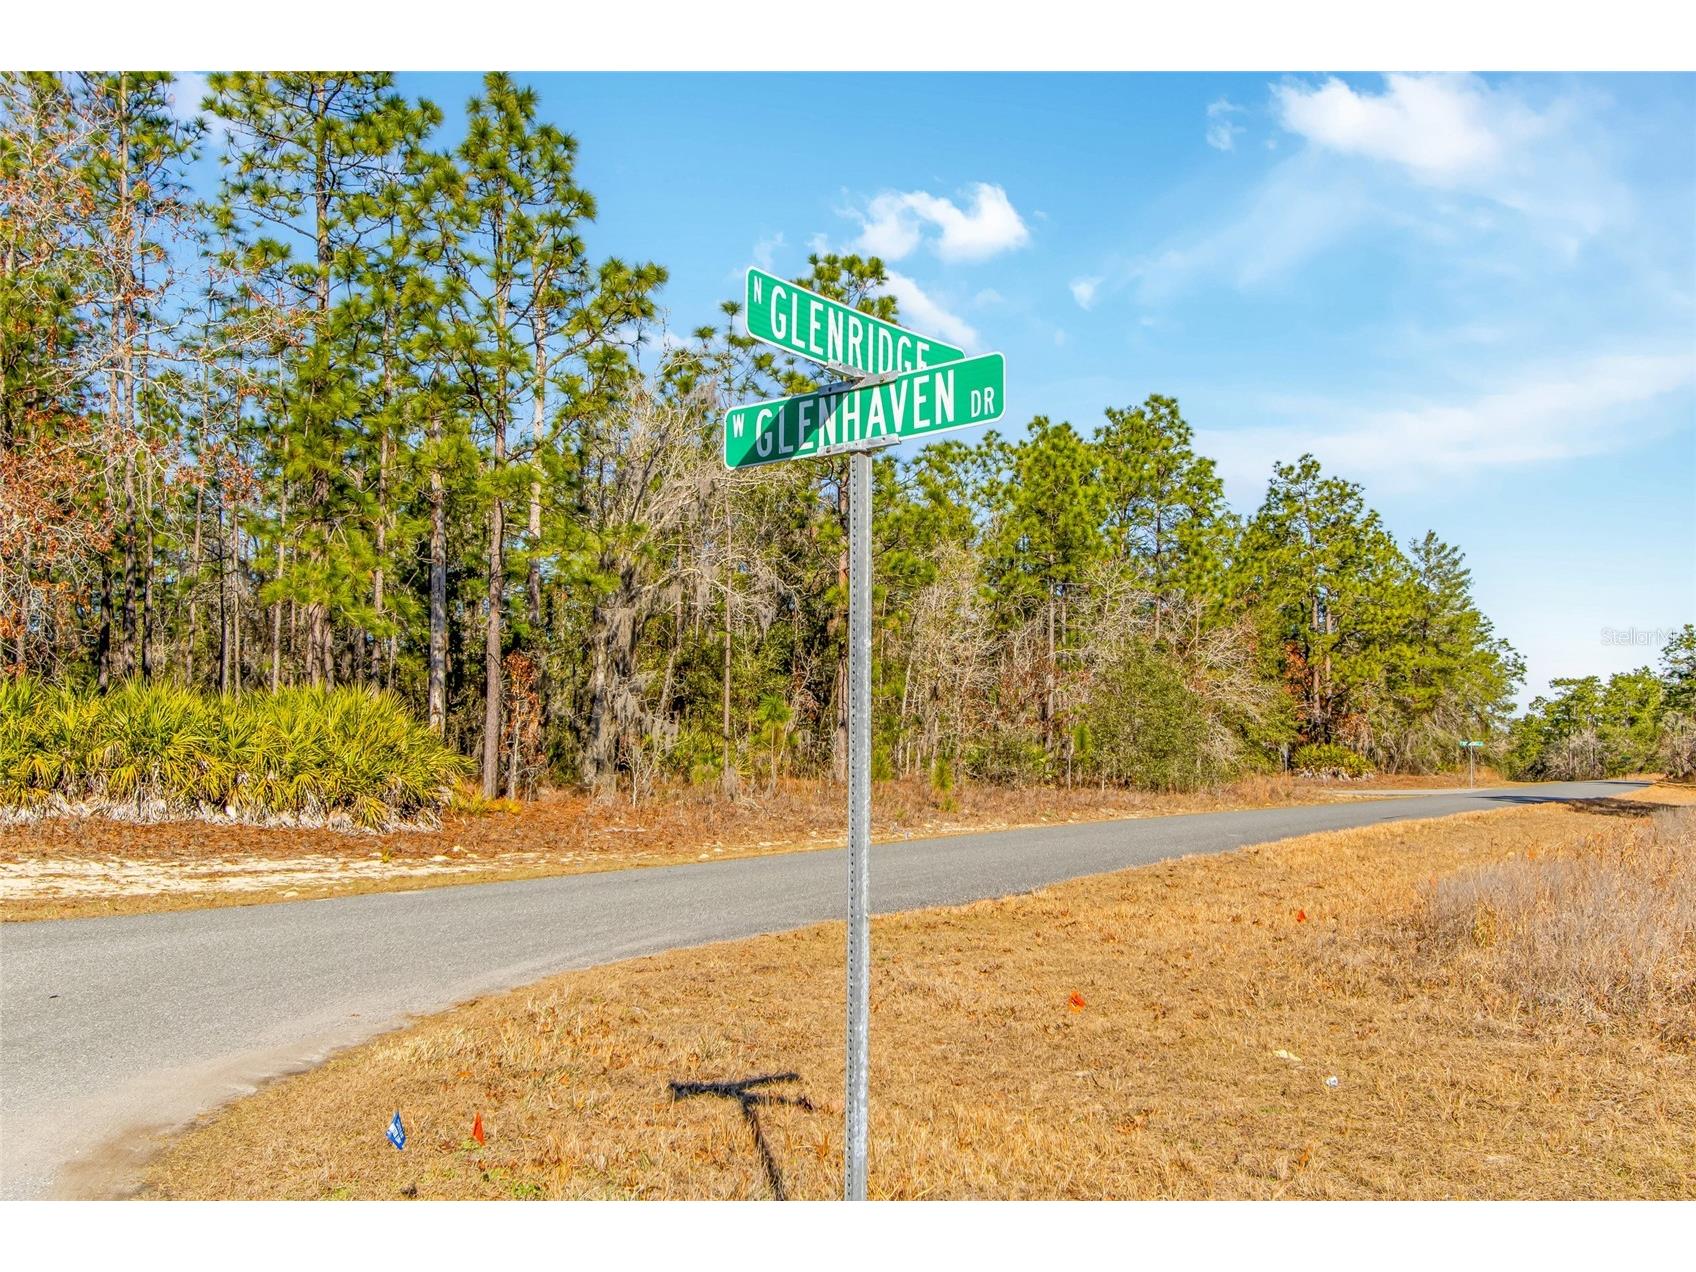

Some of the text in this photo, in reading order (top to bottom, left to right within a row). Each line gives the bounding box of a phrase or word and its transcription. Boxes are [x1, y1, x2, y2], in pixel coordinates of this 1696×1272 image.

[753, 276, 930, 374] N GLENRIDGE
[732, 370, 995, 458] W GLENHAVEN DR
